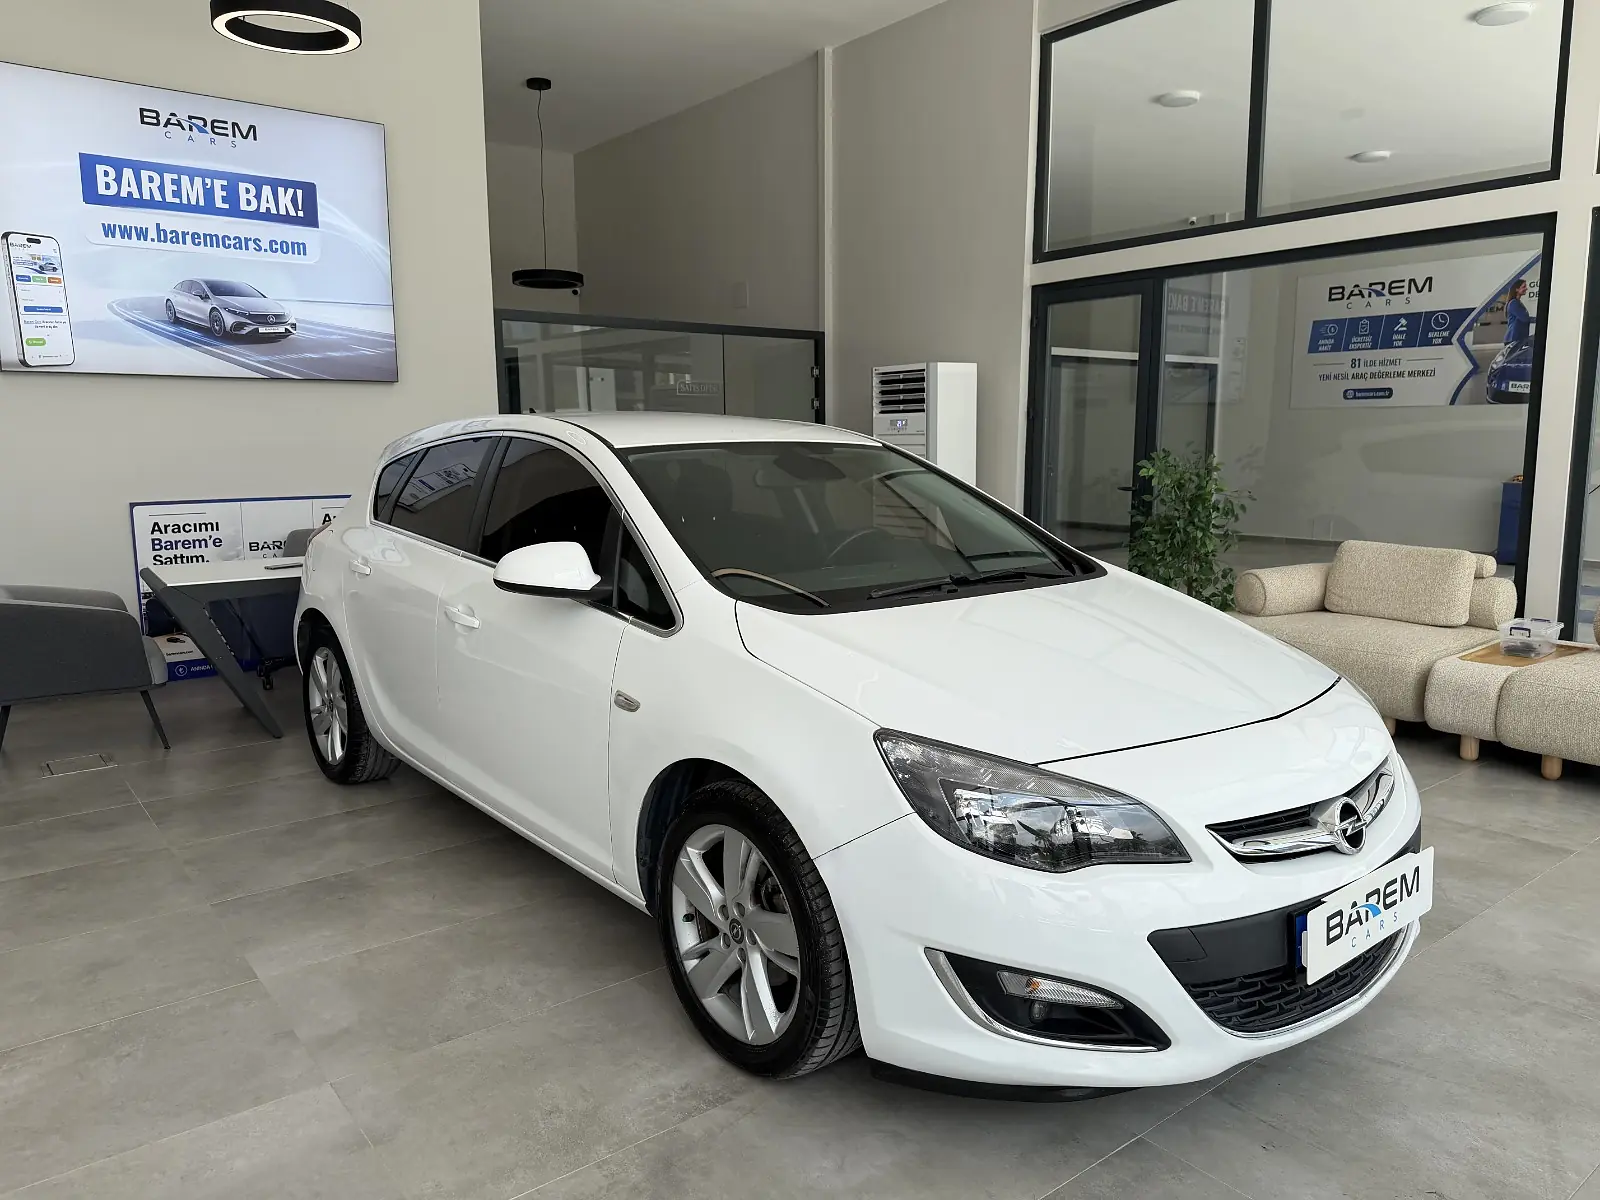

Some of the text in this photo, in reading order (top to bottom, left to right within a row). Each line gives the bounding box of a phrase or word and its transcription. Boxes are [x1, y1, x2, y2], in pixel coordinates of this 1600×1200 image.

[139, 107, 258, 142] BAREM
[164, 130, 237, 149] CARS
[95, 163, 304, 218] BAREM'E BAK!
[101, 222, 308, 256] www.baremcars.com
[1327, 276, 1433, 302] BAREM
[1346, 296, 1411, 310] CARS
[1350, 358, 1361, 369] 81
[1378, 357, 1402, 367] HİZMET
[1350, 371, 1368, 382] ARAÇ
[1369, 369, 1406, 380] DEĞERLEME
[1407, 367, 1436, 378] MERKEZİ
[150, 521, 220, 535] Aracımı
[150, 535, 223, 552] Barem'e
[248, 540, 286, 552] BAR
[152, 553, 210, 566] Sattım.
[1326, 865, 1420, 947] BAREM
[1351, 911, 1398, 948] CARS
